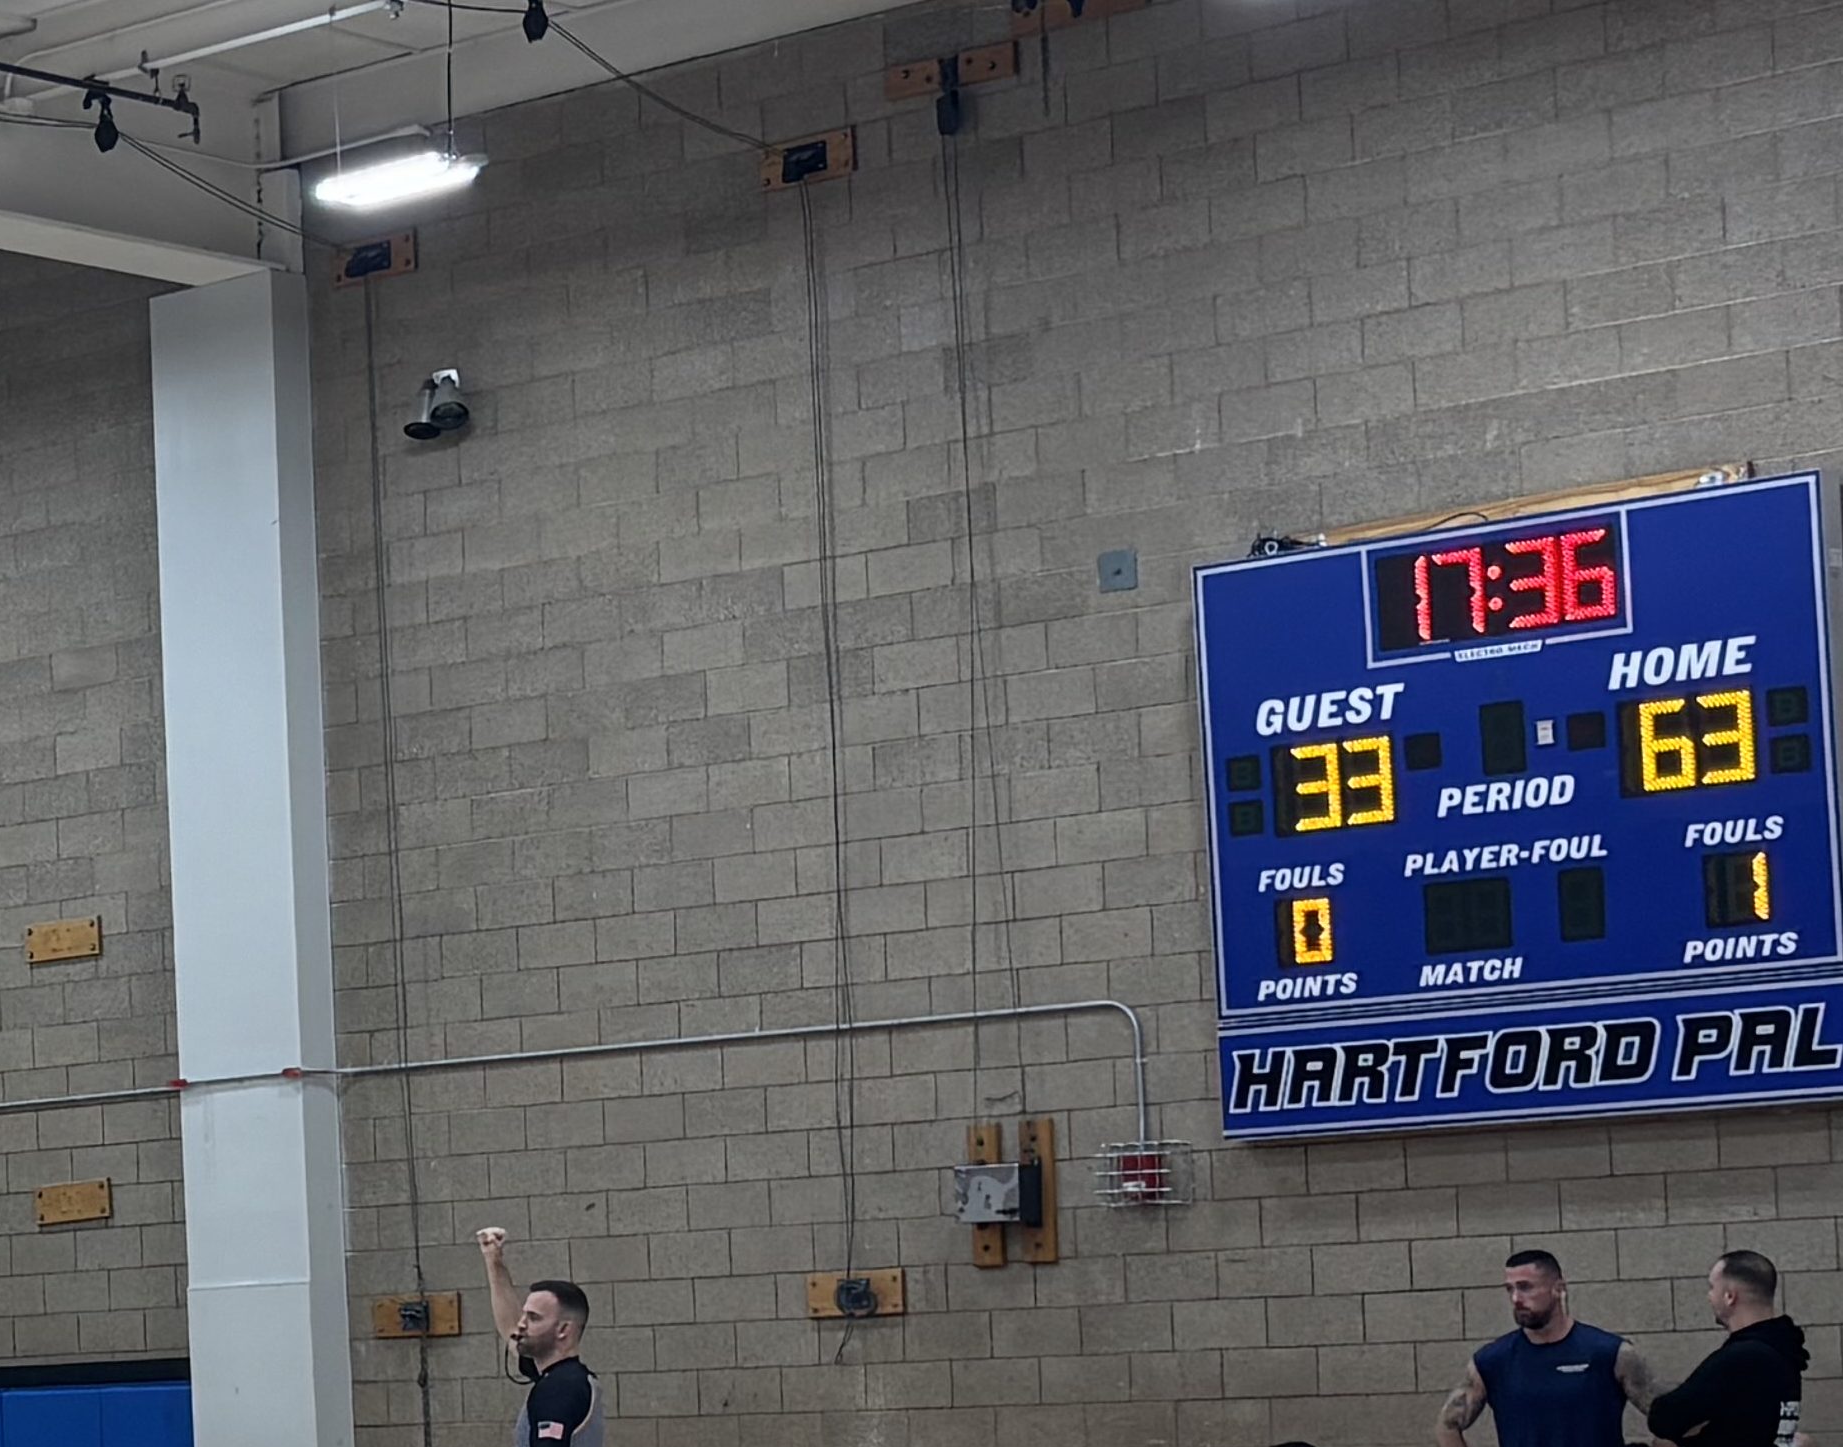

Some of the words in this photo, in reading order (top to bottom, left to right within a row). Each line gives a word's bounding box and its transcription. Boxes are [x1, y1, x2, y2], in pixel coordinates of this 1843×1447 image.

[1414, 528, 1617, 641] 17:36
[1608, 635, 1757, 690] HOME
[1256, 682, 1405, 736] GUEST
[1639, 690, 1757, 792] 63
[1290, 736, 1395, 832] 33
[1437, 774, 1575, 818] PERIOD
[1404, 834, 1608, 878] PLAYER-FOUL
[1684, 815, 1784, 848] FOULS
[1258, 862, 1345, 892] FOULS
[1751, 851, 1770, 920] 1
[1291, 897, 1333, 965] 0
[1683, 931, 1798, 964] POINTS
[1257, 972, 1358, 1002] POINTS
[1419, 957, 1524, 987] MATCH
[1229, 1017, 1661, 1114] HARTFORD
[1672, 1002, 1843, 1082] PAL
